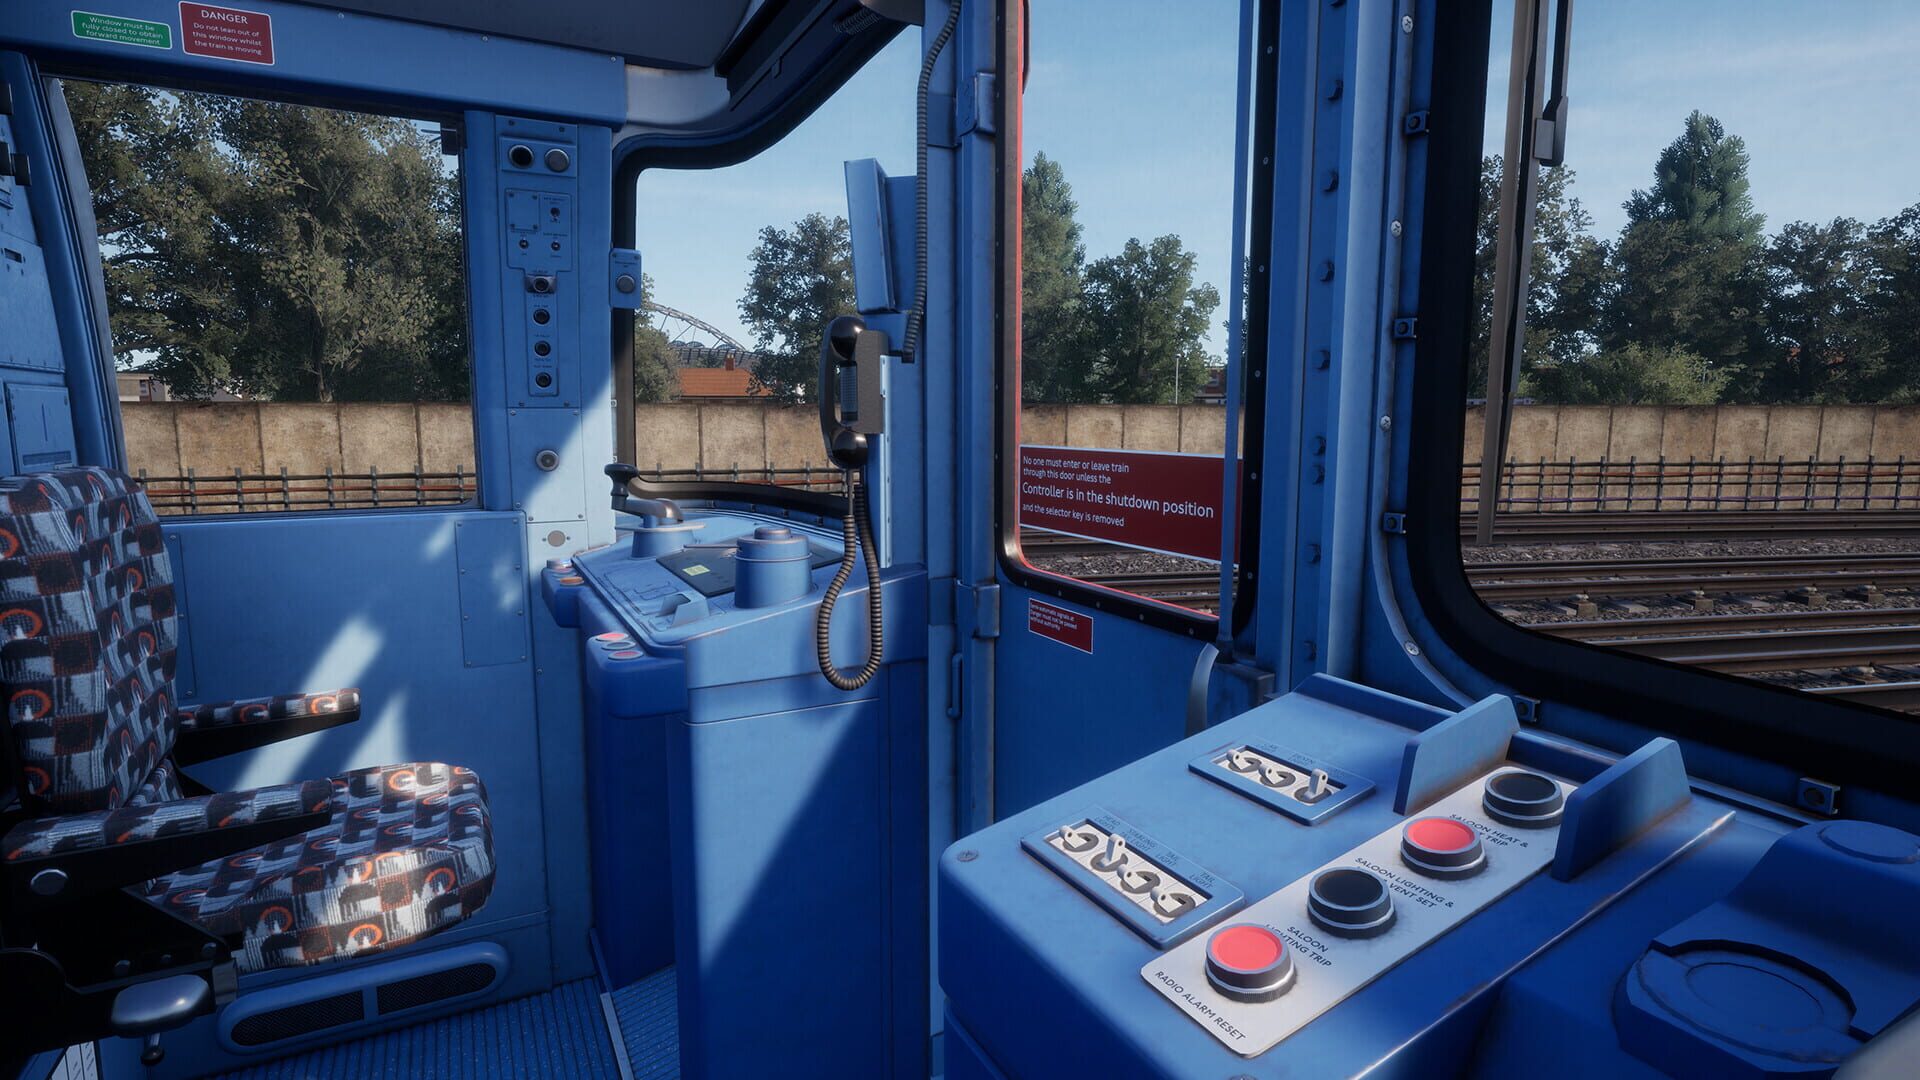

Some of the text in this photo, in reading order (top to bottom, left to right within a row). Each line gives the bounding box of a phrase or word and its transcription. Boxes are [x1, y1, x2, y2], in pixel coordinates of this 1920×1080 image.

[89, 16, 122, 26] Window
[123, 22, 144, 30] must
[201, 10, 248, 24] DANGER
[82, 22, 100, 31] fully
[102, 25, 127, 33] closed
[139, 30, 163, 39] obtain
[86, 30, 161, 45] forward movement
[220, 26, 236, 34] lean
[208, 33, 238, 43] window
[240, 38, 262, 46] whilst
[208, 41, 227, 49] train
[235, 46, 262, 56] moving
[1023, 455, 1129, 473] No one must enter or leave train
[1023, 468, 1111, 484] through this door unless the
[1022, 482, 1214, 519] Controller is in the shutdown position
[1022, 503, 1125, 527] and the selector key is removed
[1486, 835, 1508, 846] TRIP
[1492, 830, 1521, 843] HEAT
[1355, 857, 1397, 879] SALOON
[1395, 877, 1446, 903] LIGHTING
[1389, 882, 1437, 908] VENT SET
[1287, 926, 1329, 953] SALOON
[1309, 950, 1332, 967] TRIP
[1154, 970, 1247, 1042] RADIO ALARM RESET
